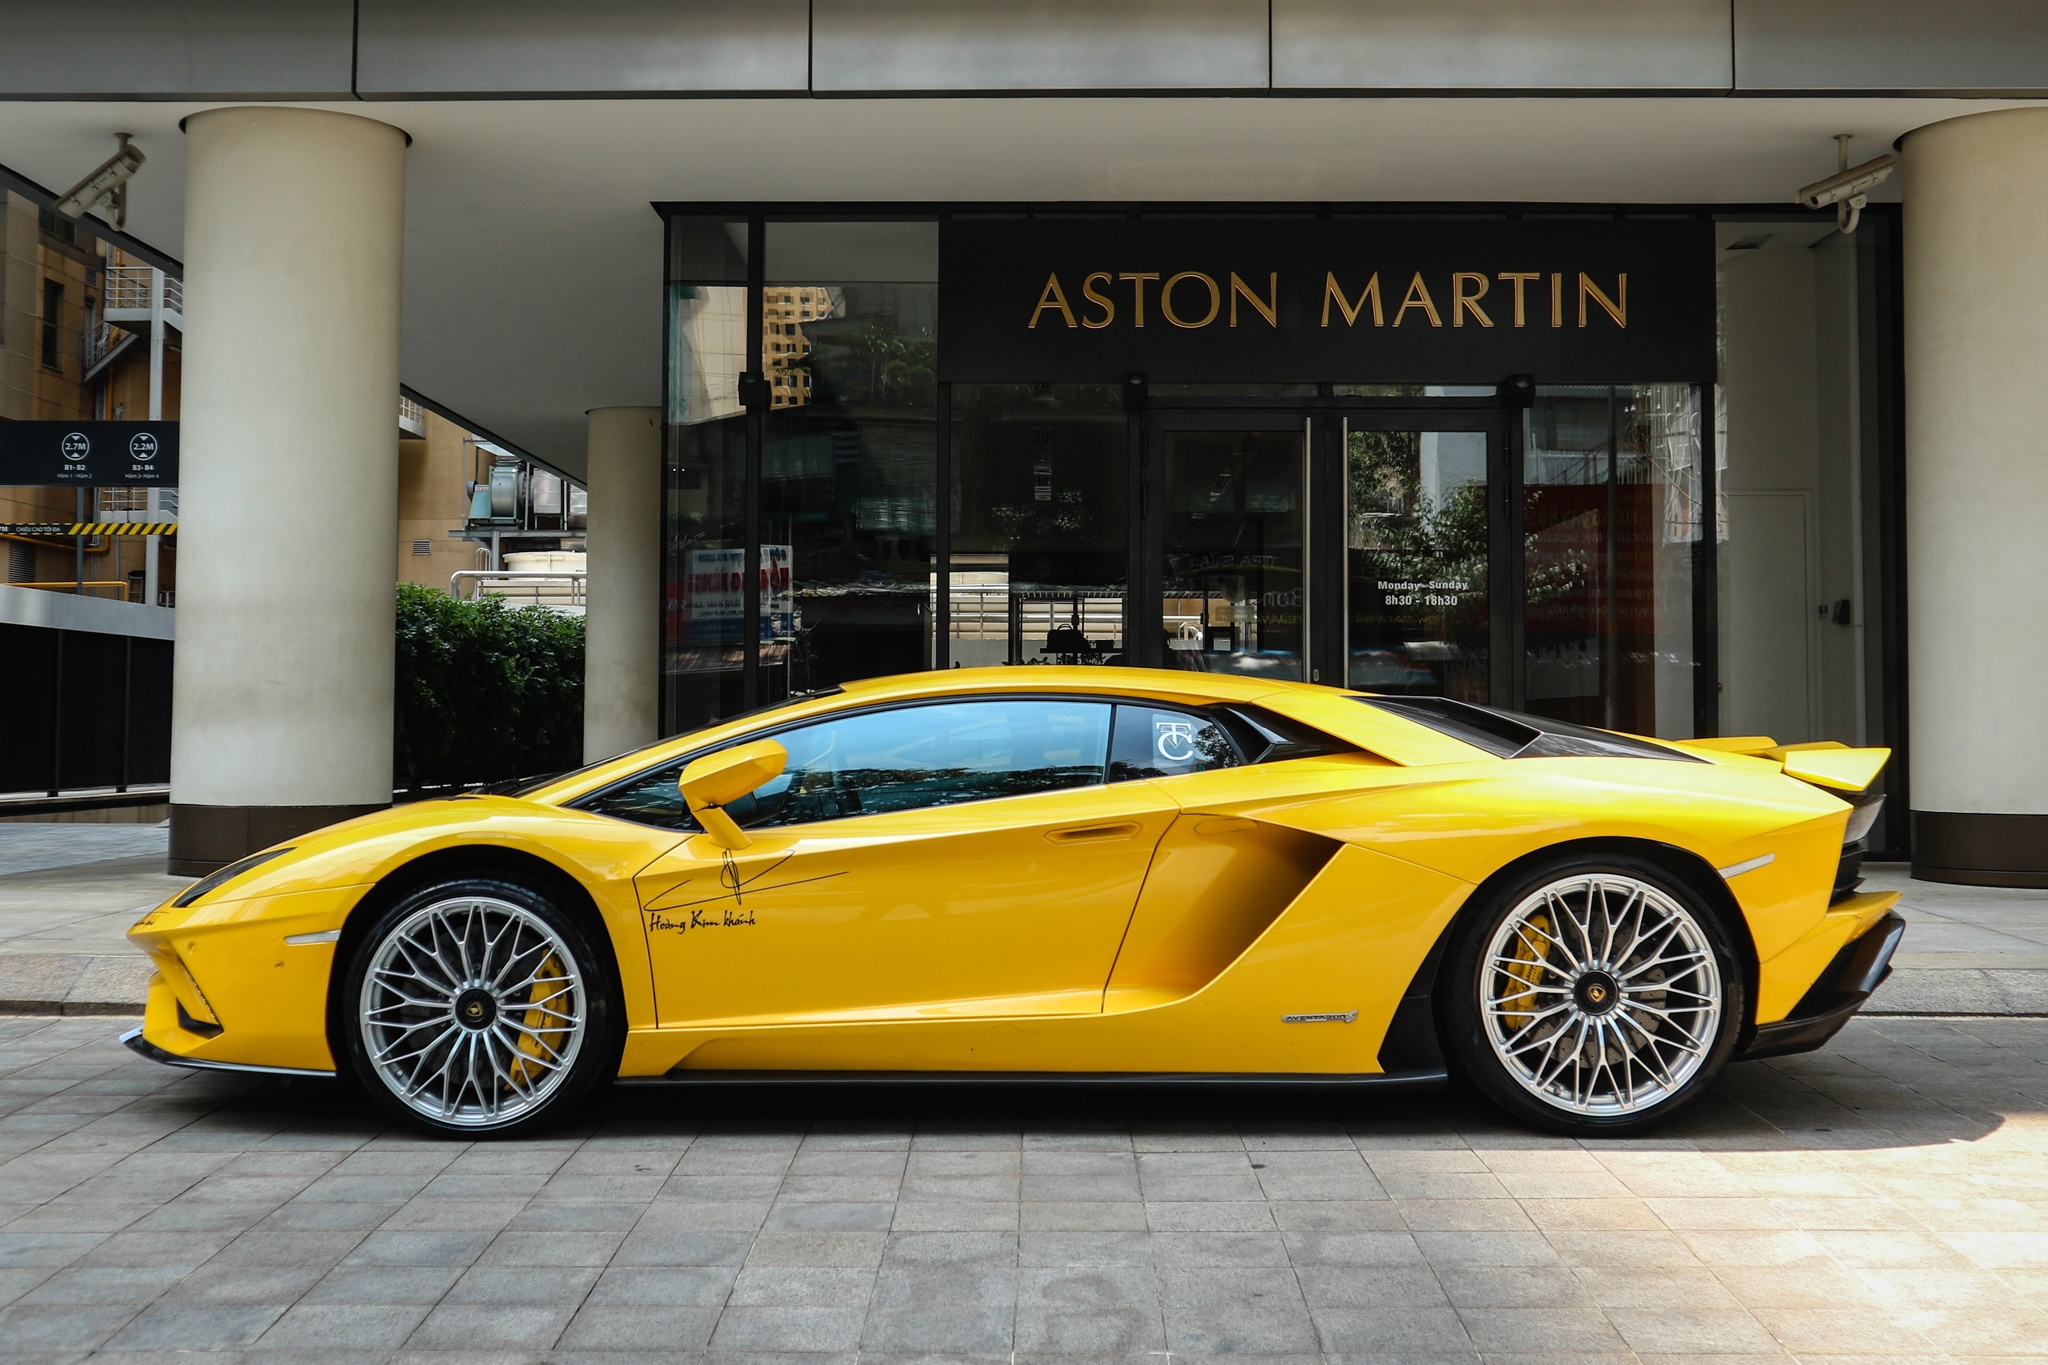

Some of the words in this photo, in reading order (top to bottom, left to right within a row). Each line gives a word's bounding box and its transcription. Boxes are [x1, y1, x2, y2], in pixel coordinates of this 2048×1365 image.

[1028, 271, 1278, 329] ASTON
[1320, 271, 1627, 329] MARTIN
[65, 442, 86, 451] 2.7M
[133, 442, 154, 451] 2.2M
[1378, 581, 1420, 591] Monday
[1428, 580, 1468, 591] Sunday
[1385, 595, 1412, 606] 8h30
[1425, 595, 1458, 606] 18h30
[649, 912, 686, 935] Hoàng
[690, 909, 720, 928] Kim
